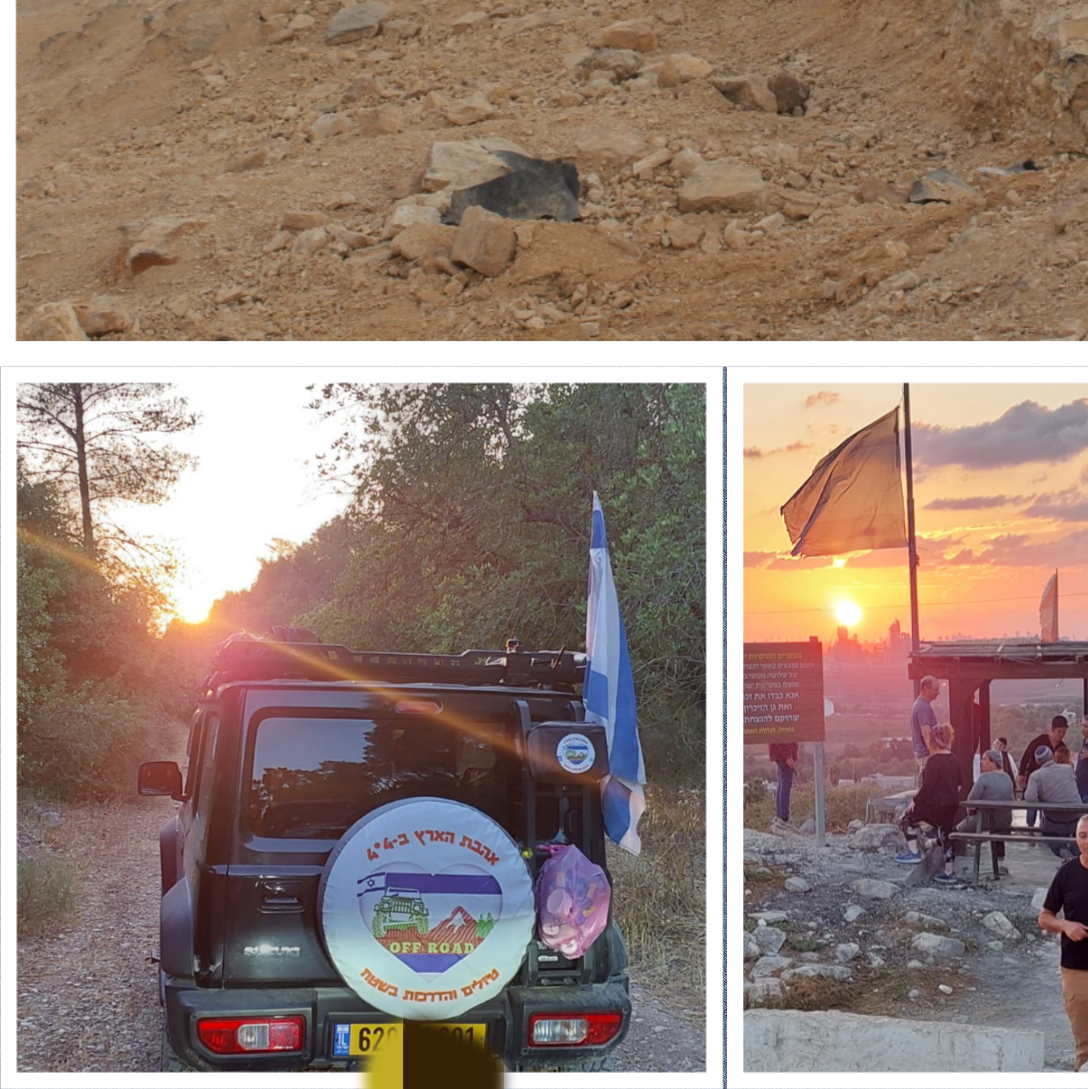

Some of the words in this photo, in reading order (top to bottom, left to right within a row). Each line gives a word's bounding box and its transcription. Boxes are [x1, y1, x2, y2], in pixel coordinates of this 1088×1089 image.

[754, 693, 766, 701] את
[785, 692, 800, 700] אנא
[414, 830, 455, 845] הארץ
[459, 836, 499, 865] אהבת
[389, 942, 421, 953] OFF
[428, 942, 475, 953] ROAD
[360, 968, 398, 996] בשטח
[461, 969, 500, 996] טיולים
[402, 990, 458, 1002] והדרכות
